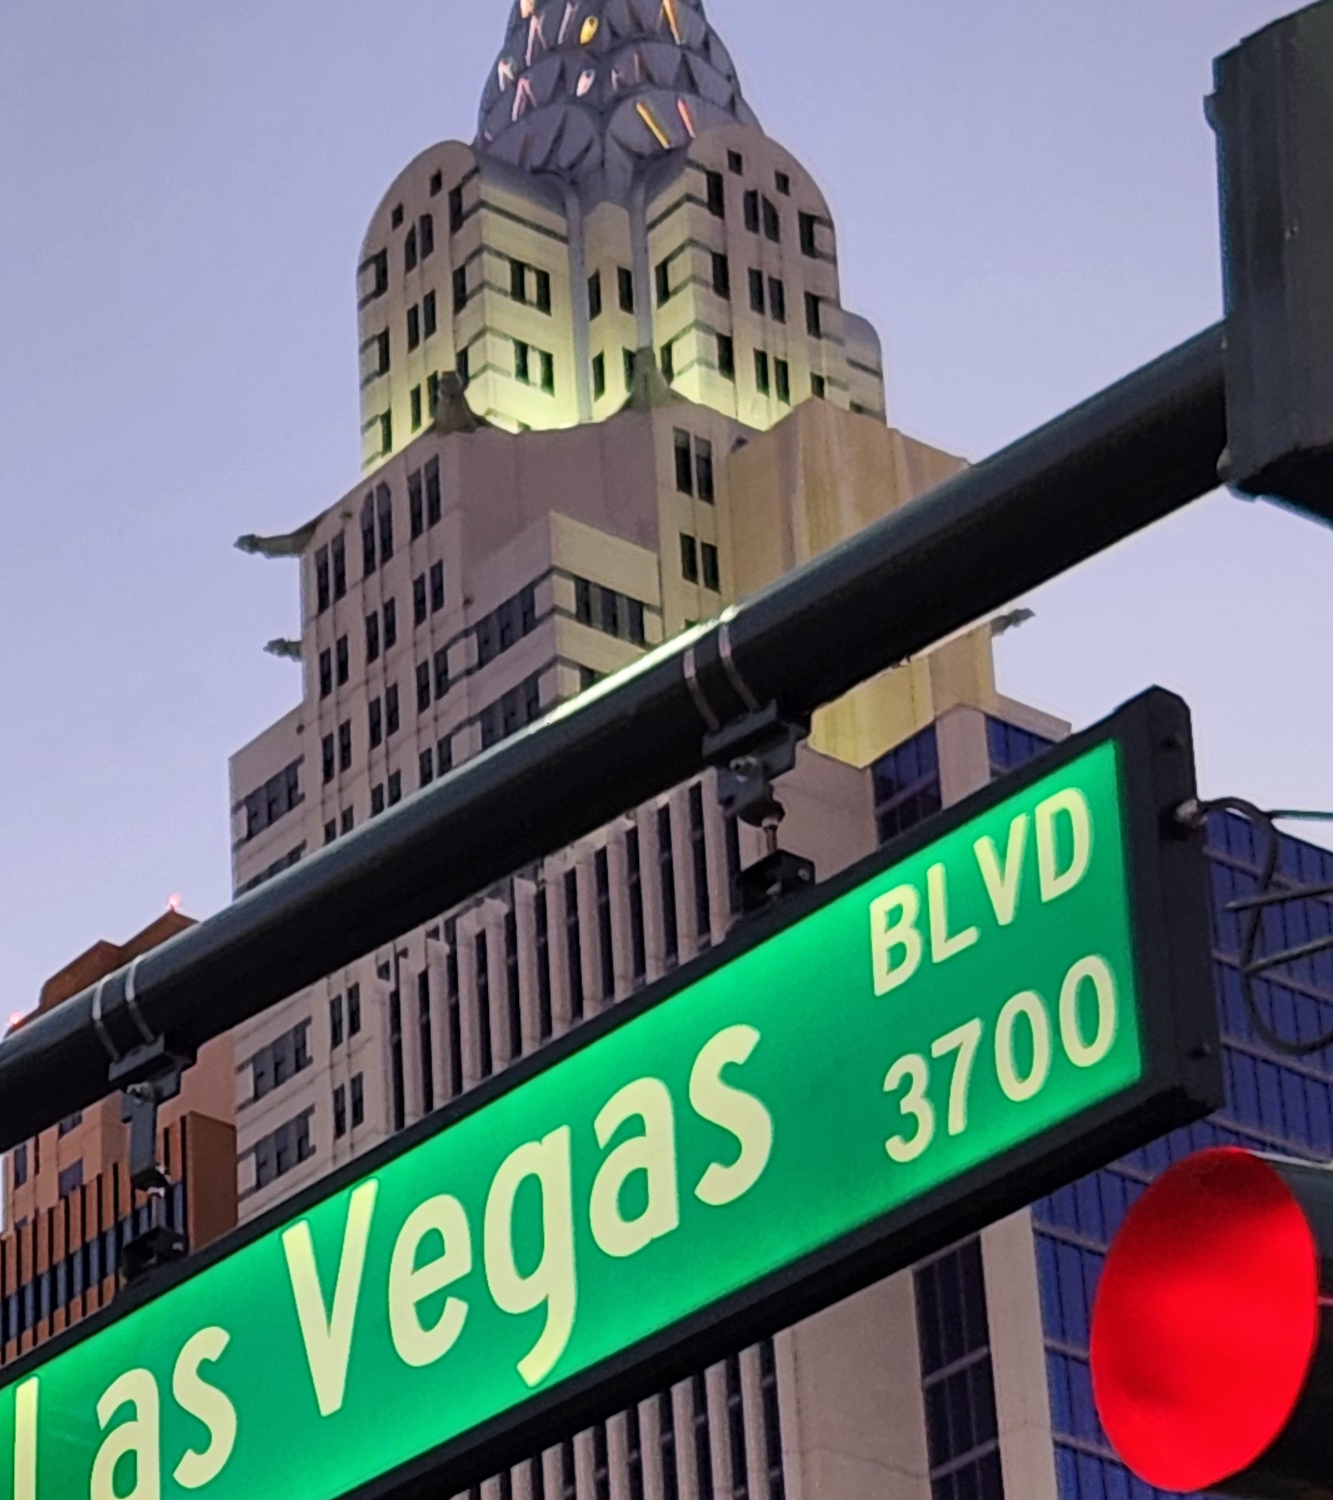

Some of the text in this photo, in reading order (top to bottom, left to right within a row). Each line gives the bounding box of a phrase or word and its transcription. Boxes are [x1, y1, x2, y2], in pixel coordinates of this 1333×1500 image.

[870, 787, 1094, 998] BLVD
[881, 953, 1120, 1165] 3700
[280, 1023, 776, 1420] Vegas
